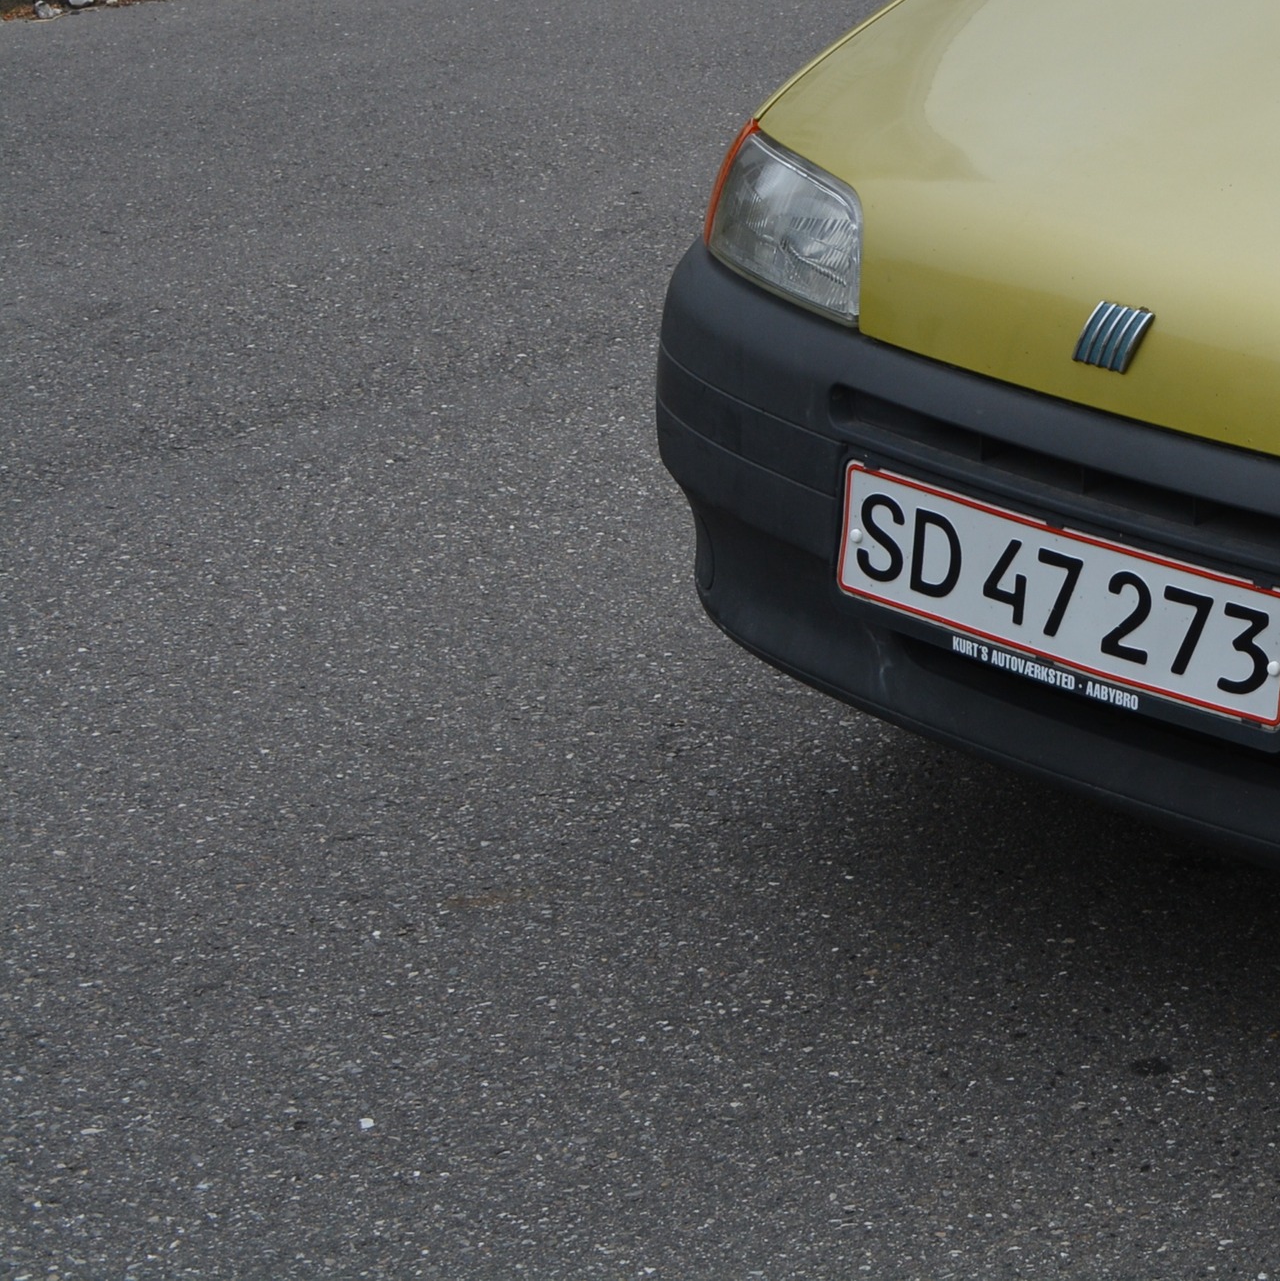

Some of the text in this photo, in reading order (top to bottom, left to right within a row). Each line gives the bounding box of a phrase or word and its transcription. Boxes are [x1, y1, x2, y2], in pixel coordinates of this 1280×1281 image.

[856, 493, 1270, 696] SD 47 273
[991, 649, 1076, 691] AUTOVÆRKSTED
[1085, 680, 1139, 711] AABYBRO
